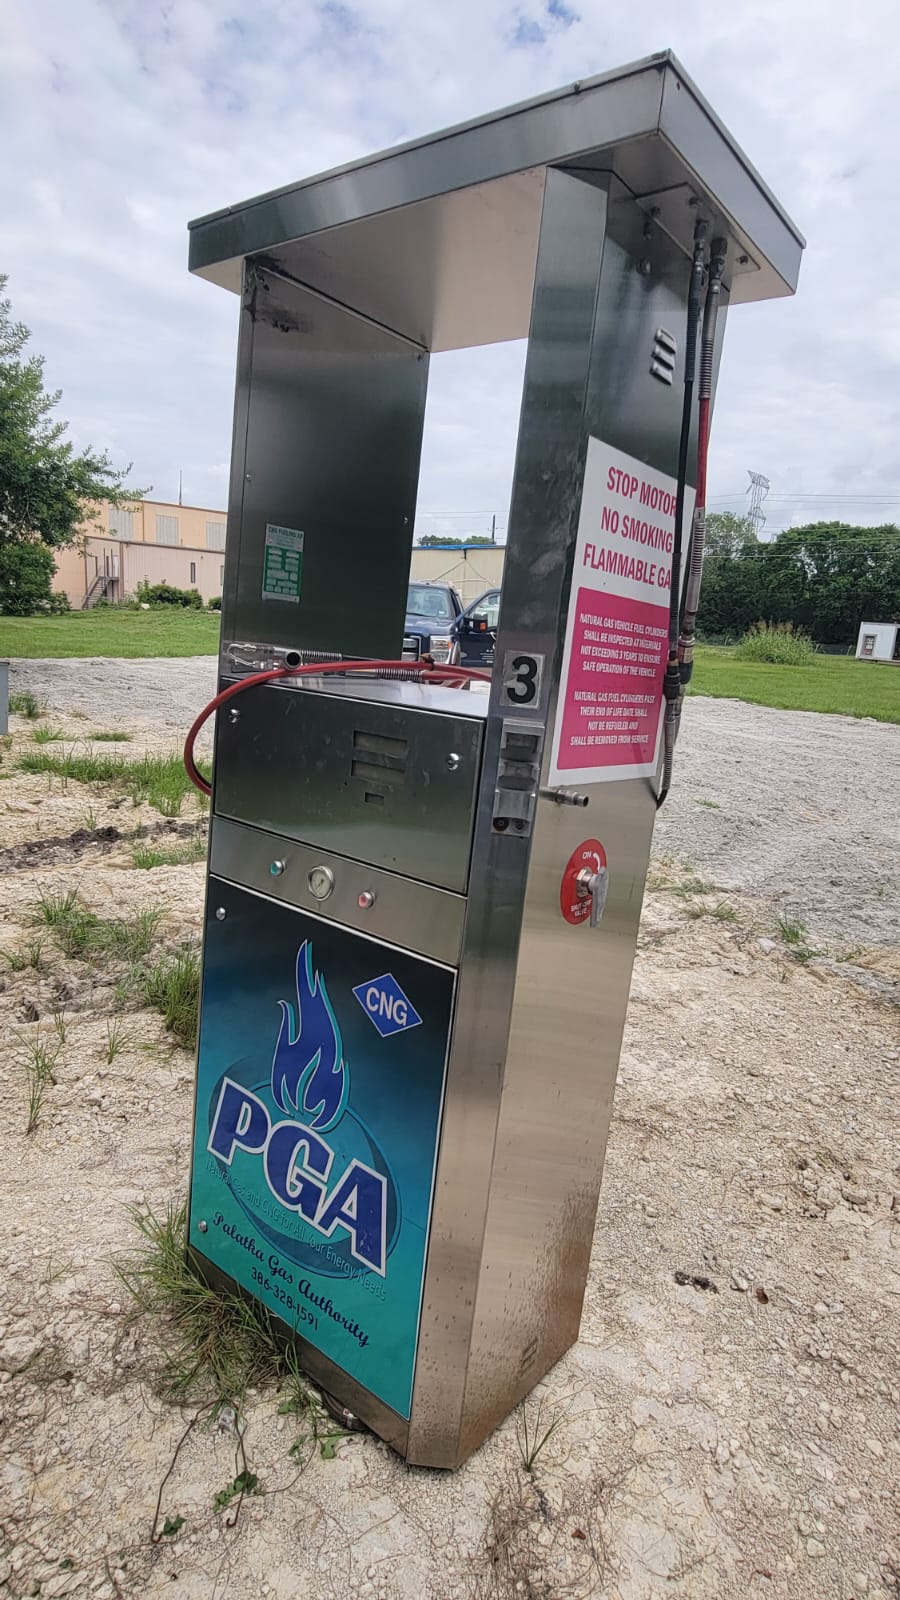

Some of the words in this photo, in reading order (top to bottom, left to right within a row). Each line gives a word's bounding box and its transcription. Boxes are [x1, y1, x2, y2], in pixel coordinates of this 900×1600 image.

[606, 466, 638, 499] STOP
[600, 506, 620, 534] NO
[621, 515, 673, 553] SMOKING
[583, 542, 656, 586] FLAMMABLE
[658, 566, 672, 590] GA
[580, 613, 602, 626] NATURAL
[604, 618, 614, 629] GAS
[614, 620, 633, 632] VEHICLE
[634, 624, 644, 634] FUEL
[645, 626, 668, 638] CYLINDERS
[581, 645, 591, 656] NOT
[592, 647, 619, 659] EXCEEDING
[619, 650, 622, 659] 3
[623, 651, 638, 661] YEARS
[639, 653, 644, 662] TO
[644, 654, 661, 664] ENSURE
[584, 630, 600, 641] SHALL
[601, 633, 608, 642] BE
[608, 634, 632, 646] INSPECTED
[633, 638, 639, 647] AT
[640, 639, 662, 651] INTERVALS
[506, 656, 538, 704] 3
[583, 661, 596, 671] SAFE
[596, 663, 622, 674] OPERATION
[623, 665, 630, 674] OF
[630, 666, 638, 676] THE
[639, 667, 656, 677] VEHICLE
[574, 691, 597, 701] NATURAL
[598, 692, 608, 702] GAS
[608, 693, 620, 702] FUEL
[580, 706, 595, 716] THEIR
[596, 707, 605, 716] END
[606, 707, 612, 716] OF
[613, 707, 622, 716] LIFE
[623, 708, 634, 716] DATE
[635, 708, 648, 717] SHALL
[588, 721, 597, 730] NOT
[598, 721, 605, 730] BE
[606, 721, 628, 730] REFUELED
[629, 722, 638, 730] AND
[570, 736, 586, 746] SHALL
[587, 736, 594, 745] BE
[595, 736, 617, 745] REMOVED
[618, 735, 630, 744] FROM
[631, 735, 648, 744] SERVICE
[582, 850, 592, 859] ON
[366, 987, 408, 1026] CNG
[207, 1076, 387, 1278] PGA
[248, 1192, 260, 1208] and
[282, 1213, 293, 1232] for
[294, 1222, 305, 1240] All
[326, 1246, 356, 1280] Energy
[355, 1268, 386, 1302] Needs
[213, 1211, 264, 1262] Palatka
[268, 1255, 294, 1284] Gas
[298, 1279, 369, 1347] Authority
[251, 1266, 318, 1331] 386-328-1591
